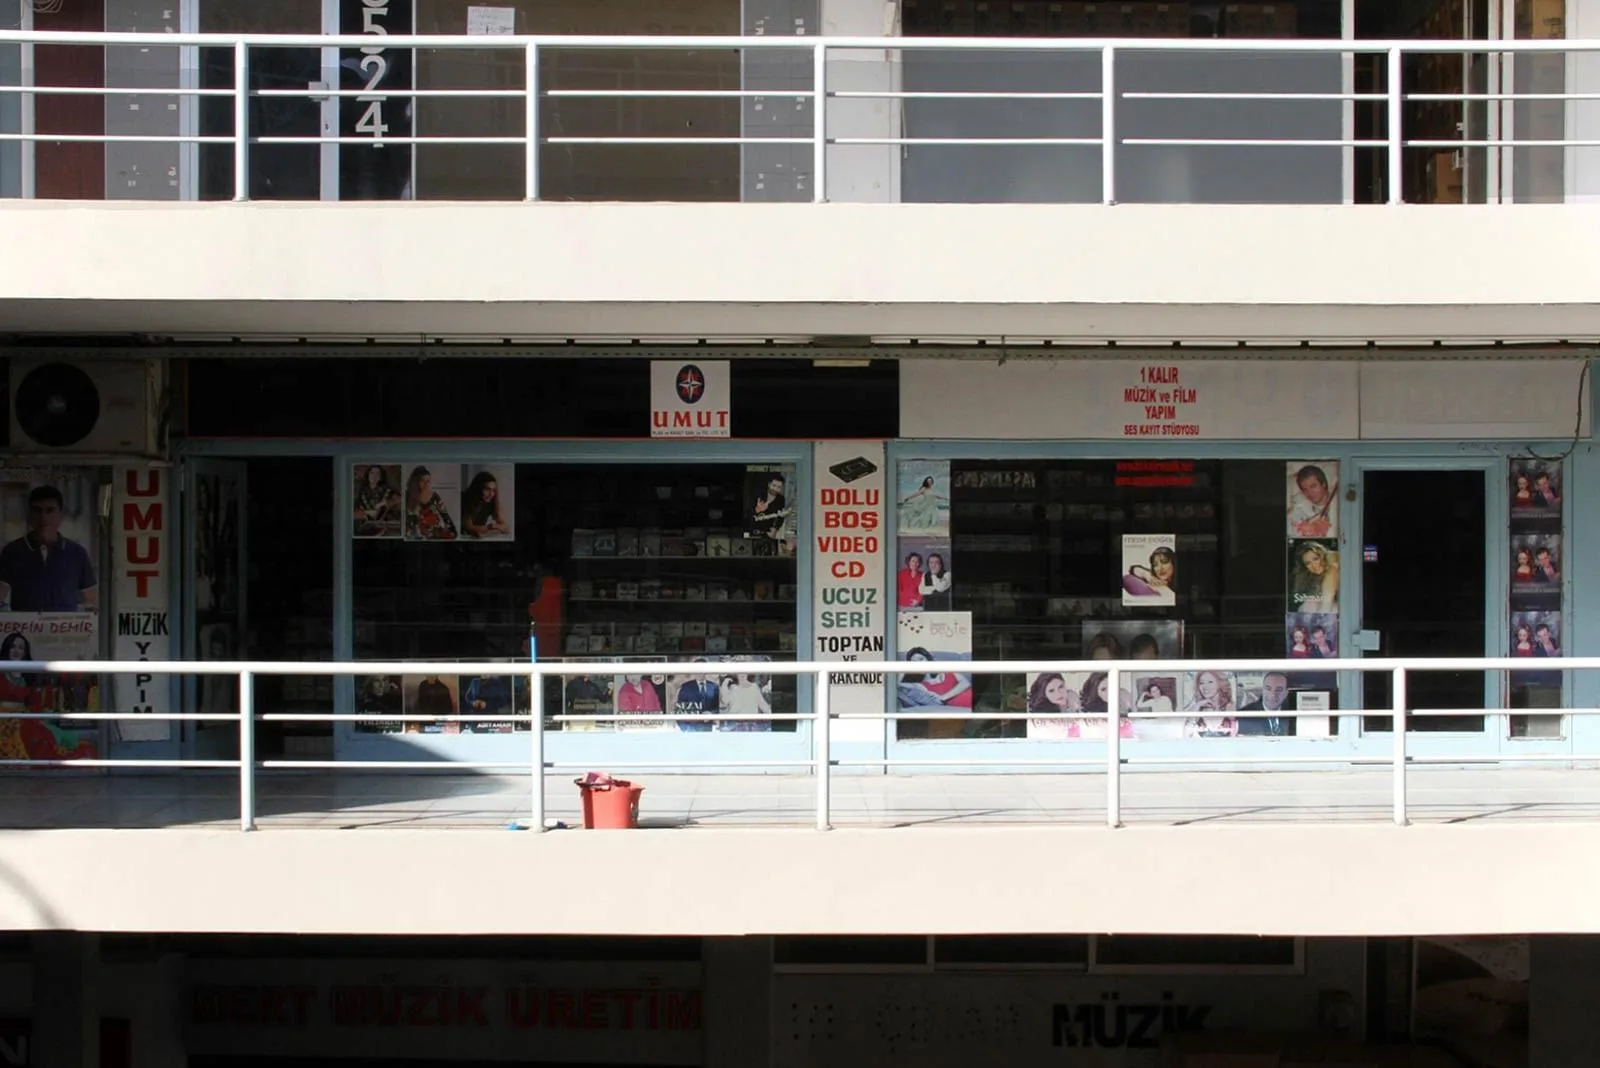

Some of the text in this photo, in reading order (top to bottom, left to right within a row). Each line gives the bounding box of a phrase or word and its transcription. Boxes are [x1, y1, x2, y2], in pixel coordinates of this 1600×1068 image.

[355, 0, 389, 148] 524
[1140, 366, 1179, 384] 1 KALIR
[1124, 385, 1197, 403] MÜZİK ve FİLM
[653, 410, 729, 428] UMUT
[1145, 405, 1176, 420] YAPIM
[1124, 421, 1200, 436] SES KAYIT STÜDYOSU
[820, 488, 880, 506] DOLU
[824, 511, 879, 532] BOŞ
[123, 470, 163, 598] UMUT
[817, 536, 879, 554] VIDEO
[831, 561, 866, 579] CD
[822, 588, 878, 605] UCUZ
[118, 612, 169, 637] MÜZİK
[821, 606, 871, 629] SERİ
[817, 636, 884, 653] TOPTAN
[133, 641, 153, 716] YPIM
[829, 671, 883, 685] RAKENDE
[330, 972, 488, 1027] MÜZİK
[507, 974, 702, 1031] ÜRETİM
[1053, 990, 1212, 1048] MÜZİK
